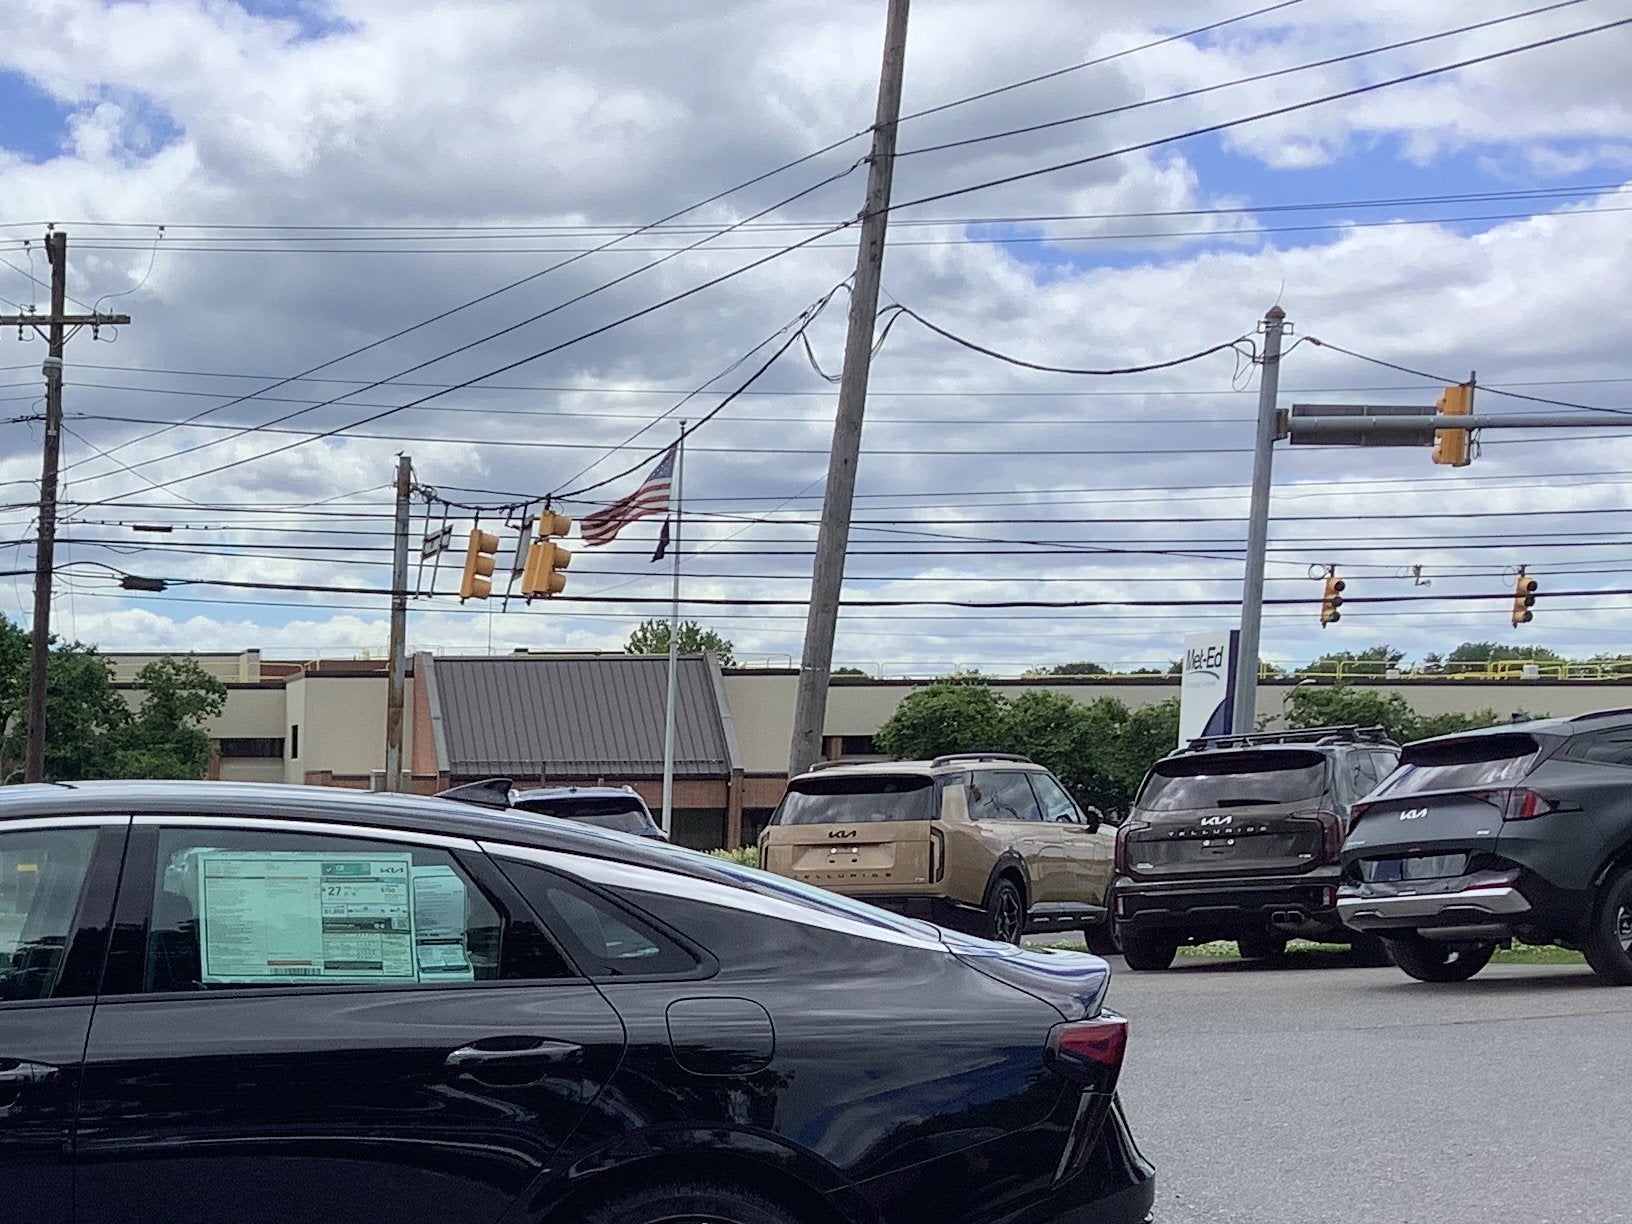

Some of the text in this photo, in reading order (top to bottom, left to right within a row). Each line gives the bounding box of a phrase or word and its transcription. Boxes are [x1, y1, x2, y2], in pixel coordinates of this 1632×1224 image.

[1186, 645, 1224, 670] Met-Ed
[1201, 815, 1233, 826] KIA
[1399, 808, 1428, 821] KIA
[828, 830, 857, 839] KIA
[1168, 825, 1267, 837] TELLURIDE
